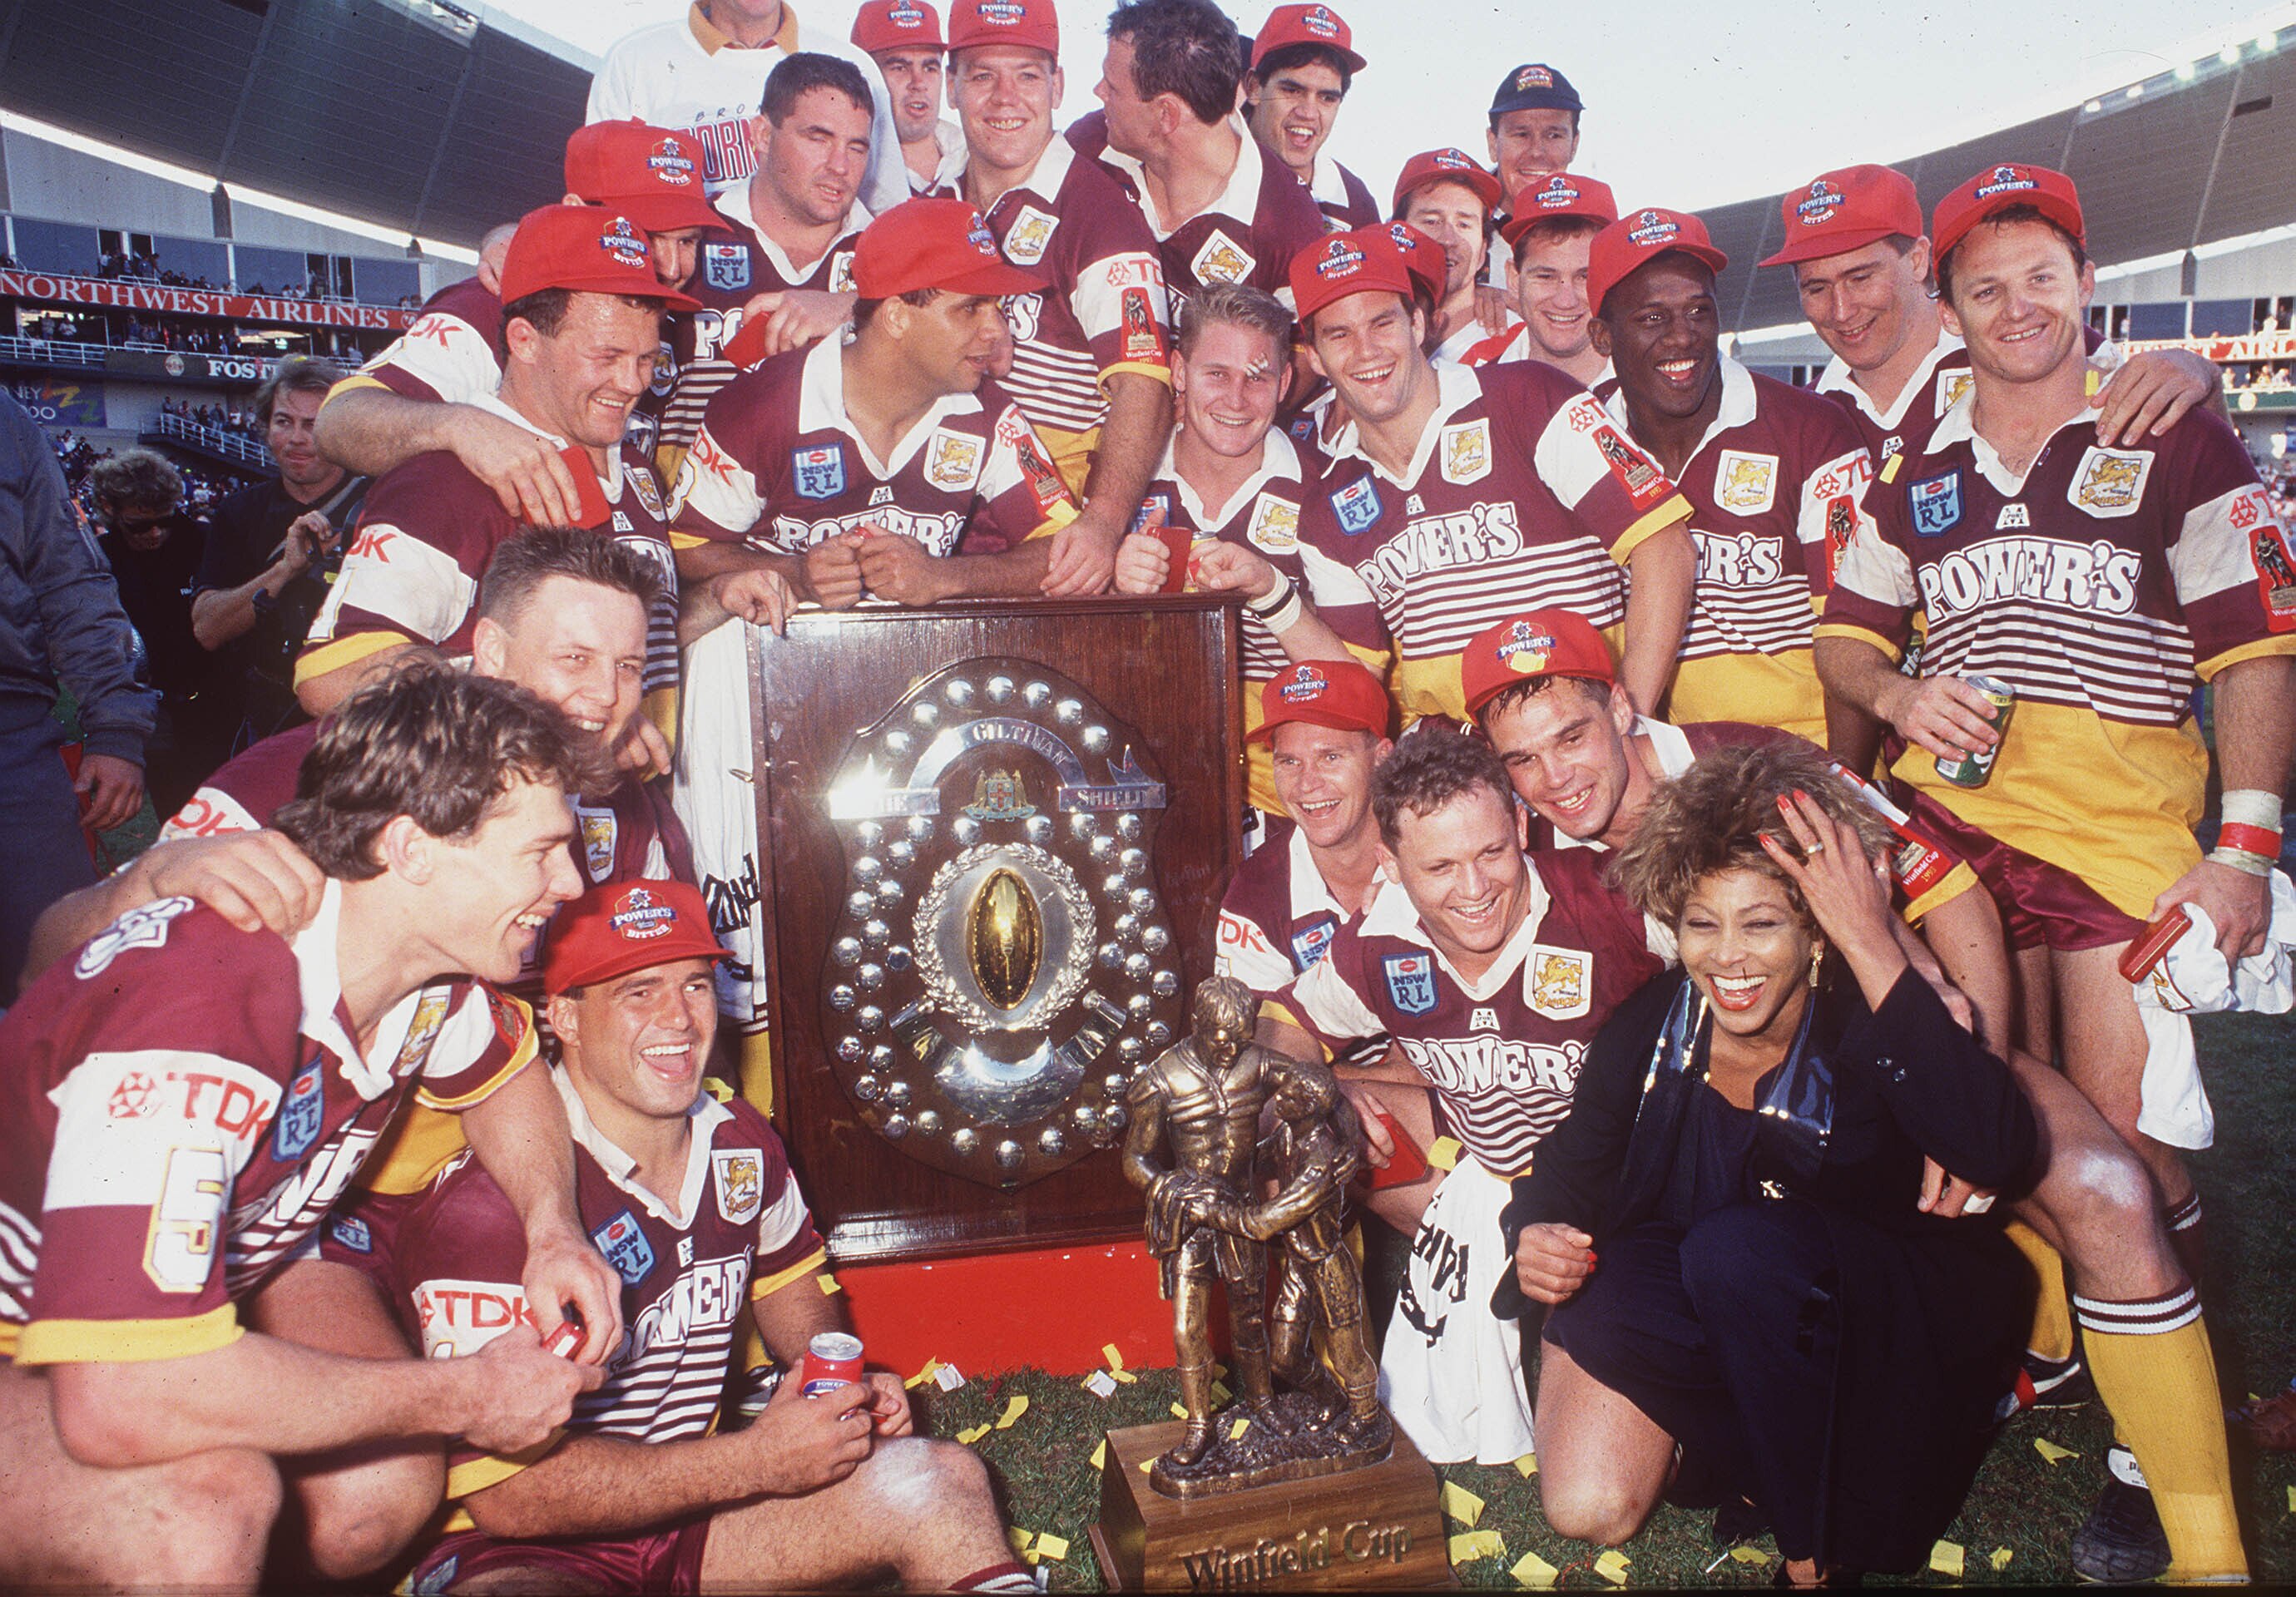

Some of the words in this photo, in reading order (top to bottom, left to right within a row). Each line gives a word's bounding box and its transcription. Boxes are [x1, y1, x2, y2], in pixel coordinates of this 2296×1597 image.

[695, 103, 763, 122] BRO
[1978, 180, 2034, 198] POWER'S
[1799, 194, 1842, 213] POWER'S
[710, 257, 745, 267] NSW
[1319, 251, 1363, 270] POWER'S
[0, 271, 231, 317] NORTHWEST
[245, 298, 389, 329] AIRLINES
[801, 462, 836, 476] NSW
[1340, 489, 1370, 512] NSW
[1917, 489, 1954, 510] NSW
[1917, 535, 2143, 627] POWER'S
[1500, 635, 1551, 657] POWER'S
[1284, 680, 1326, 695] POWER'S
[613, 906, 672, 926] POWER'S
[626, 923, 670, 939] BITTER
[1392, 972, 1428, 986] NSW
[1398, 1033, 1592, 1099] POWER'
[606, 1229, 639, 1263] NSW
[433, 1290, 541, 1332] TDK
[1180, 1525, 1330, 1591] Winfield
[1343, 1519, 1413, 1565] Cup
